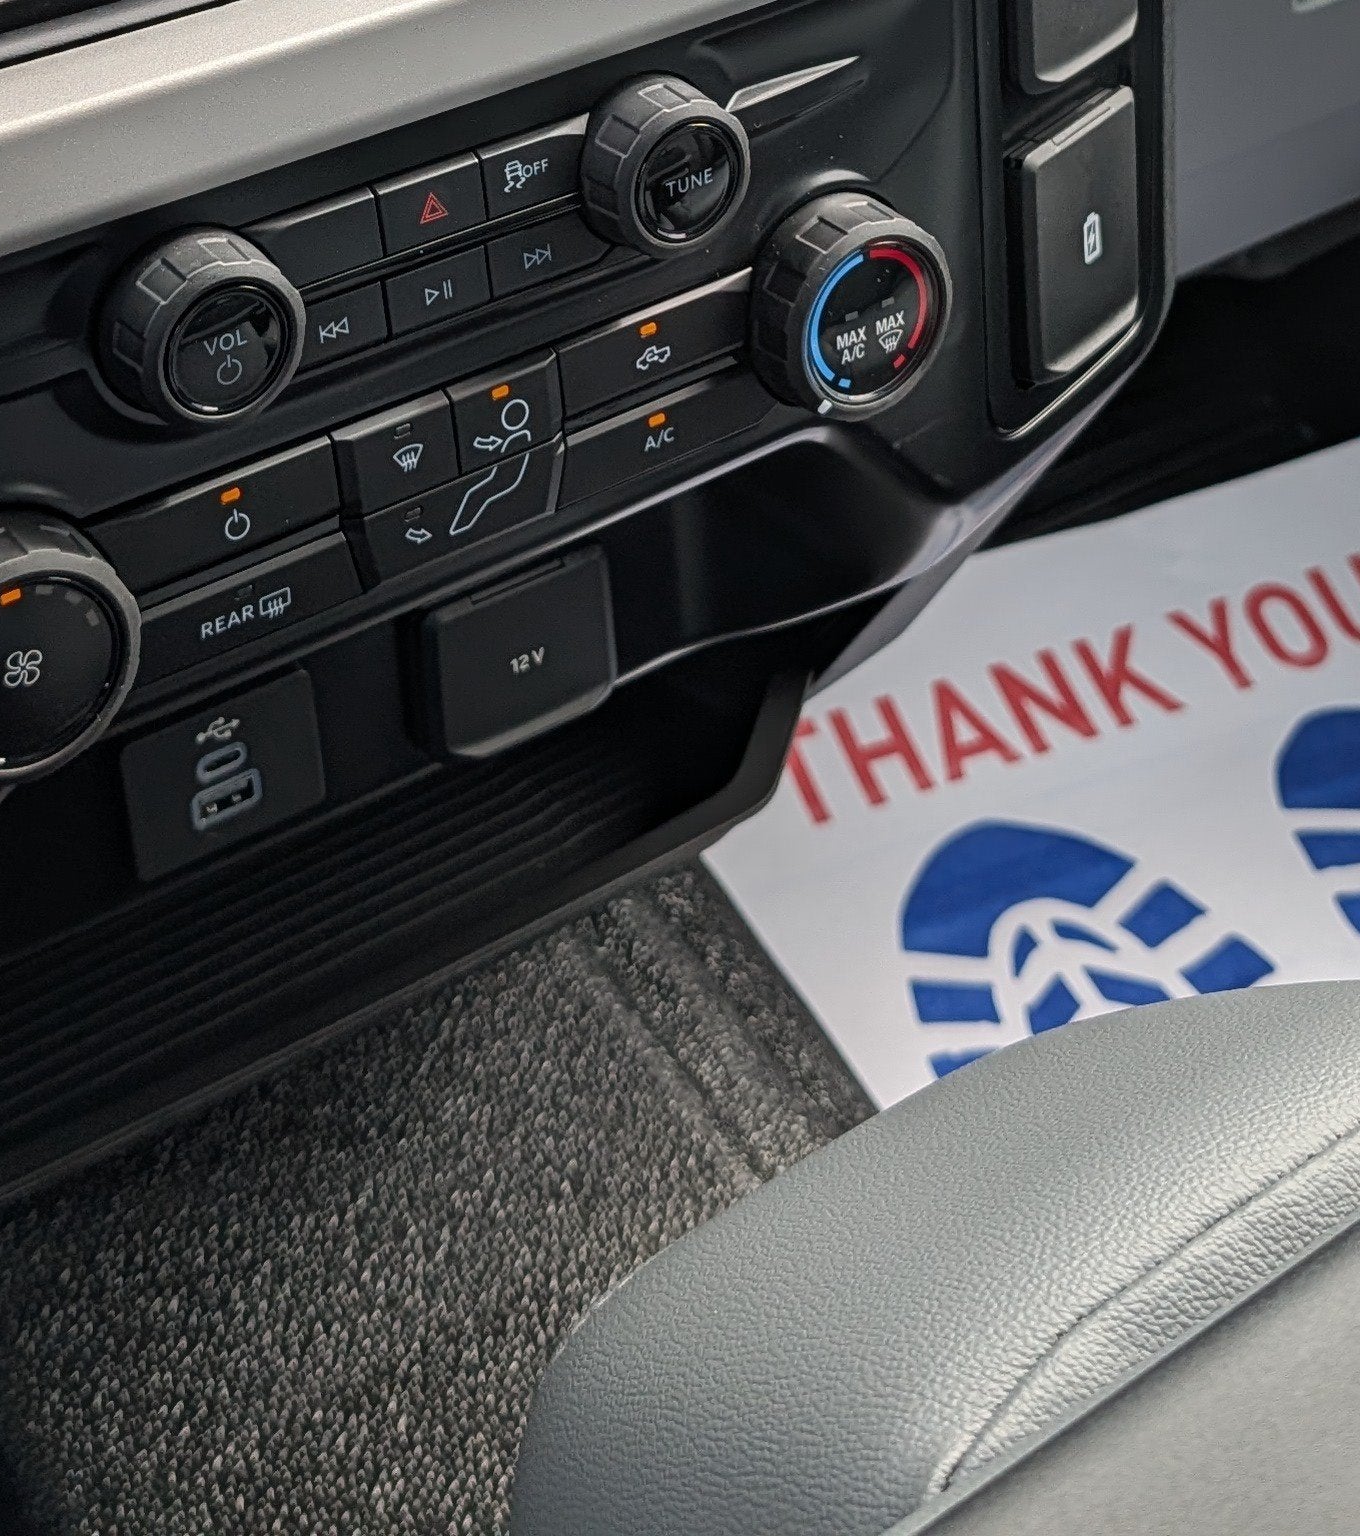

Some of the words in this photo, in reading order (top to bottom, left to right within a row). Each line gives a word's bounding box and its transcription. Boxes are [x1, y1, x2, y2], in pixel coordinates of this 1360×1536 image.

[522, 158, 549, 179] OFF
[665, 166, 714, 198] TUNE
[875, 309, 906, 335] MAX
[202, 328, 248, 357] VOL
[836, 325, 868, 351] MAX
[841, 343, 866, 365] A/C
[644, 426, 675, 452] A/C
[200, 603, 255, 640] REAR
[785, 622, 1189, 827] THANK
